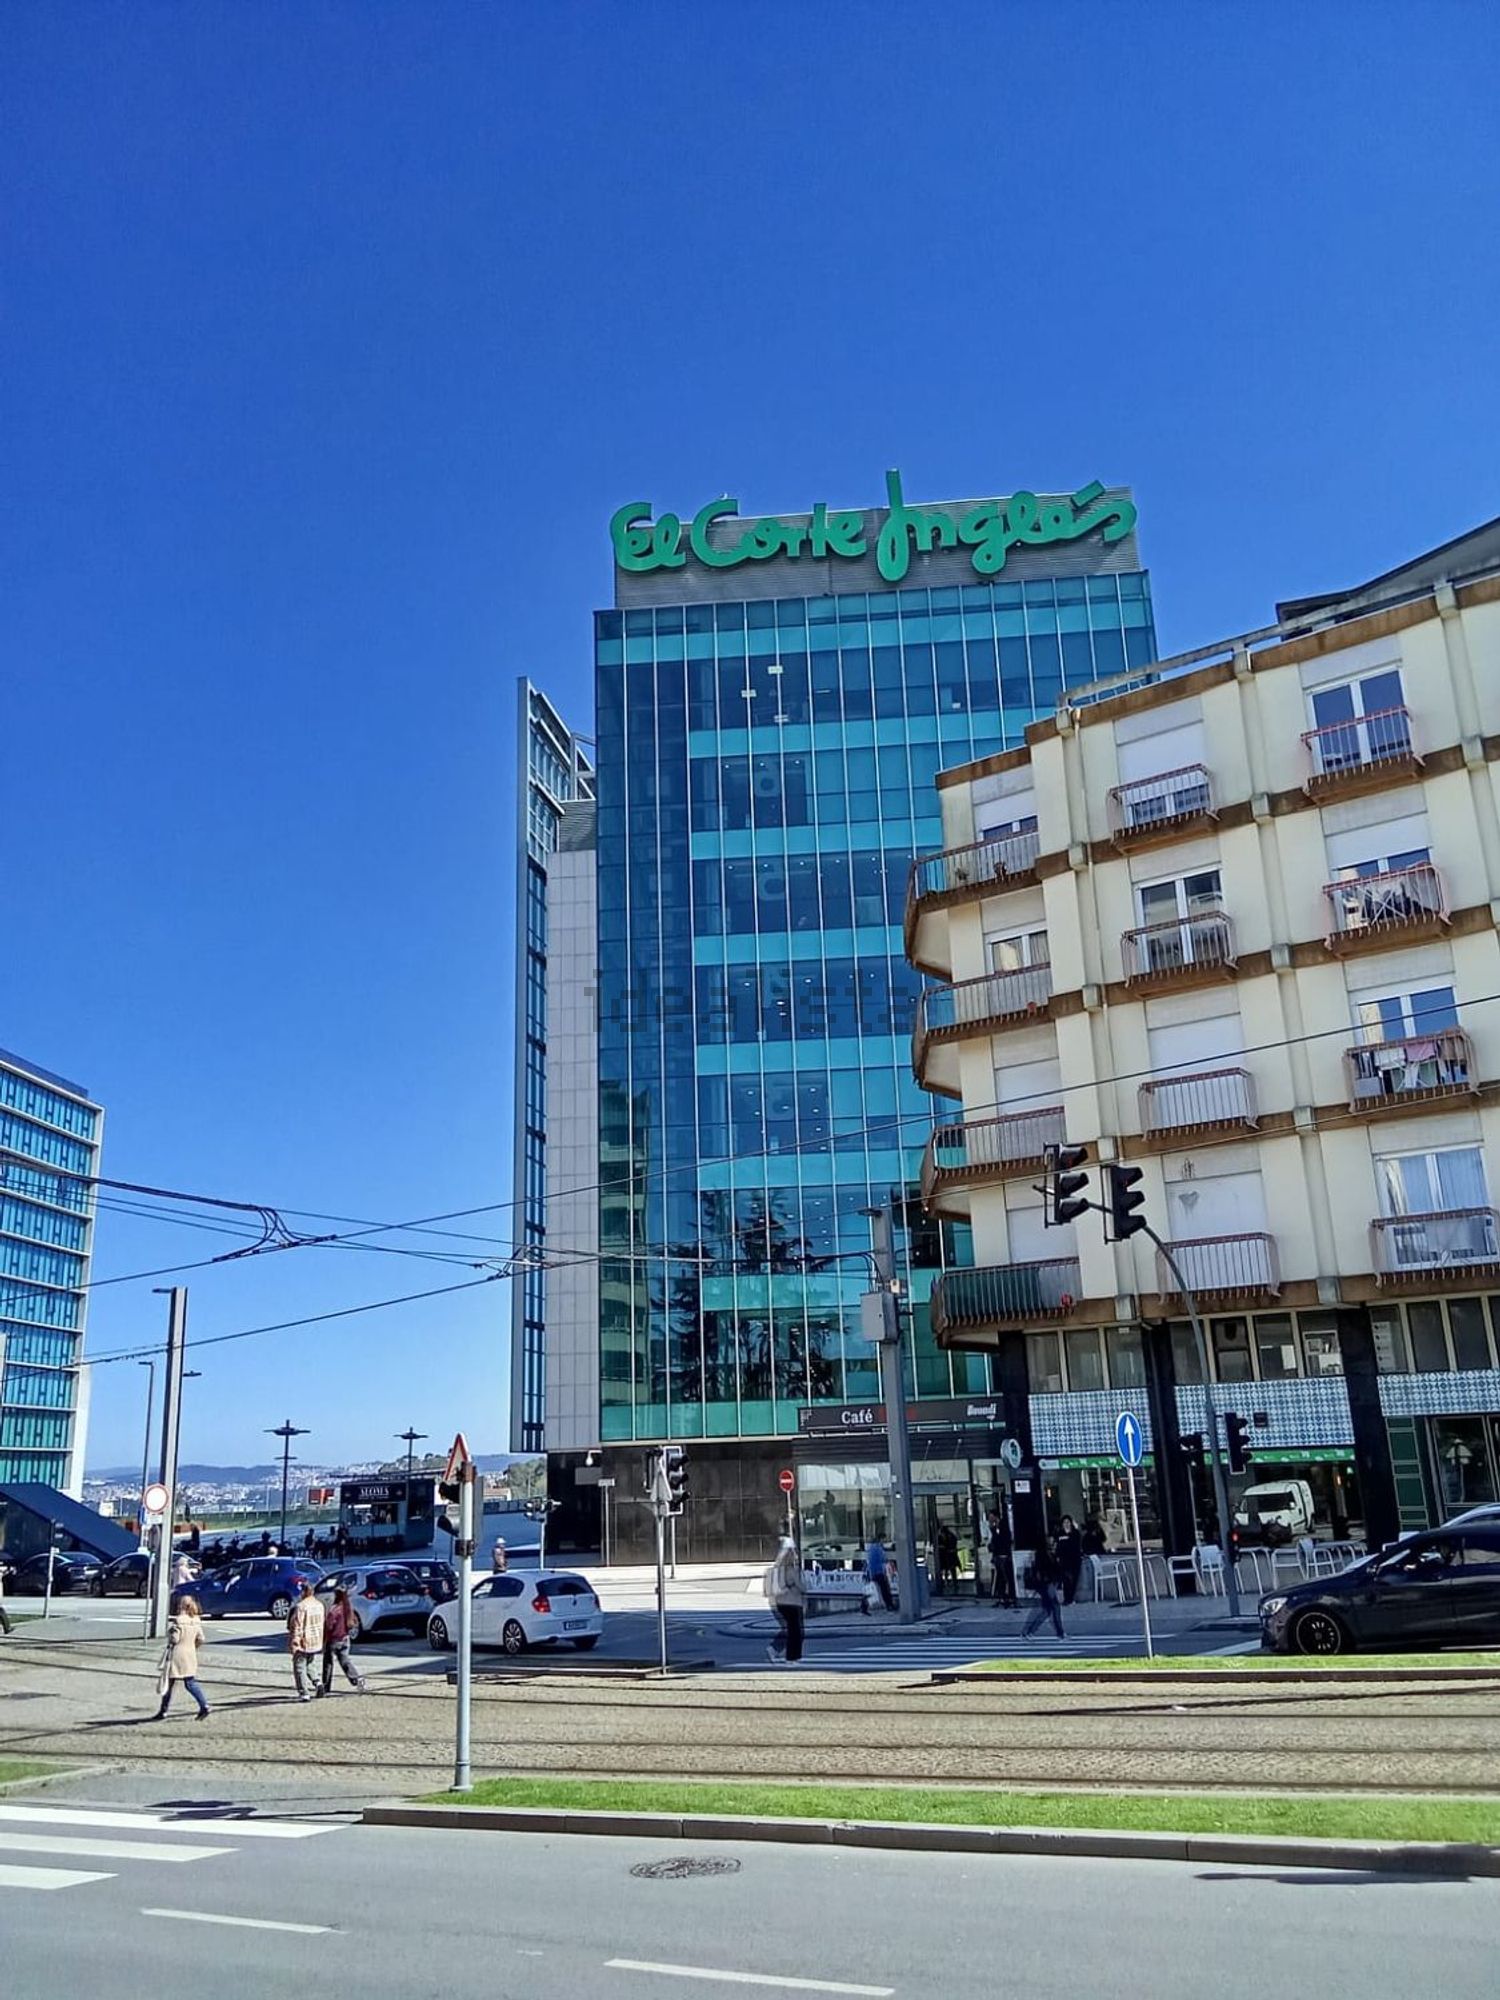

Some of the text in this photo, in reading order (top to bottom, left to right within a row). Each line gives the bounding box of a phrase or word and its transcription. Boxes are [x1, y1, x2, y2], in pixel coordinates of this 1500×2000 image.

[609, 469, 1138, 582] El Corte Inglés
[841, 1408, 873, 1424] Café
